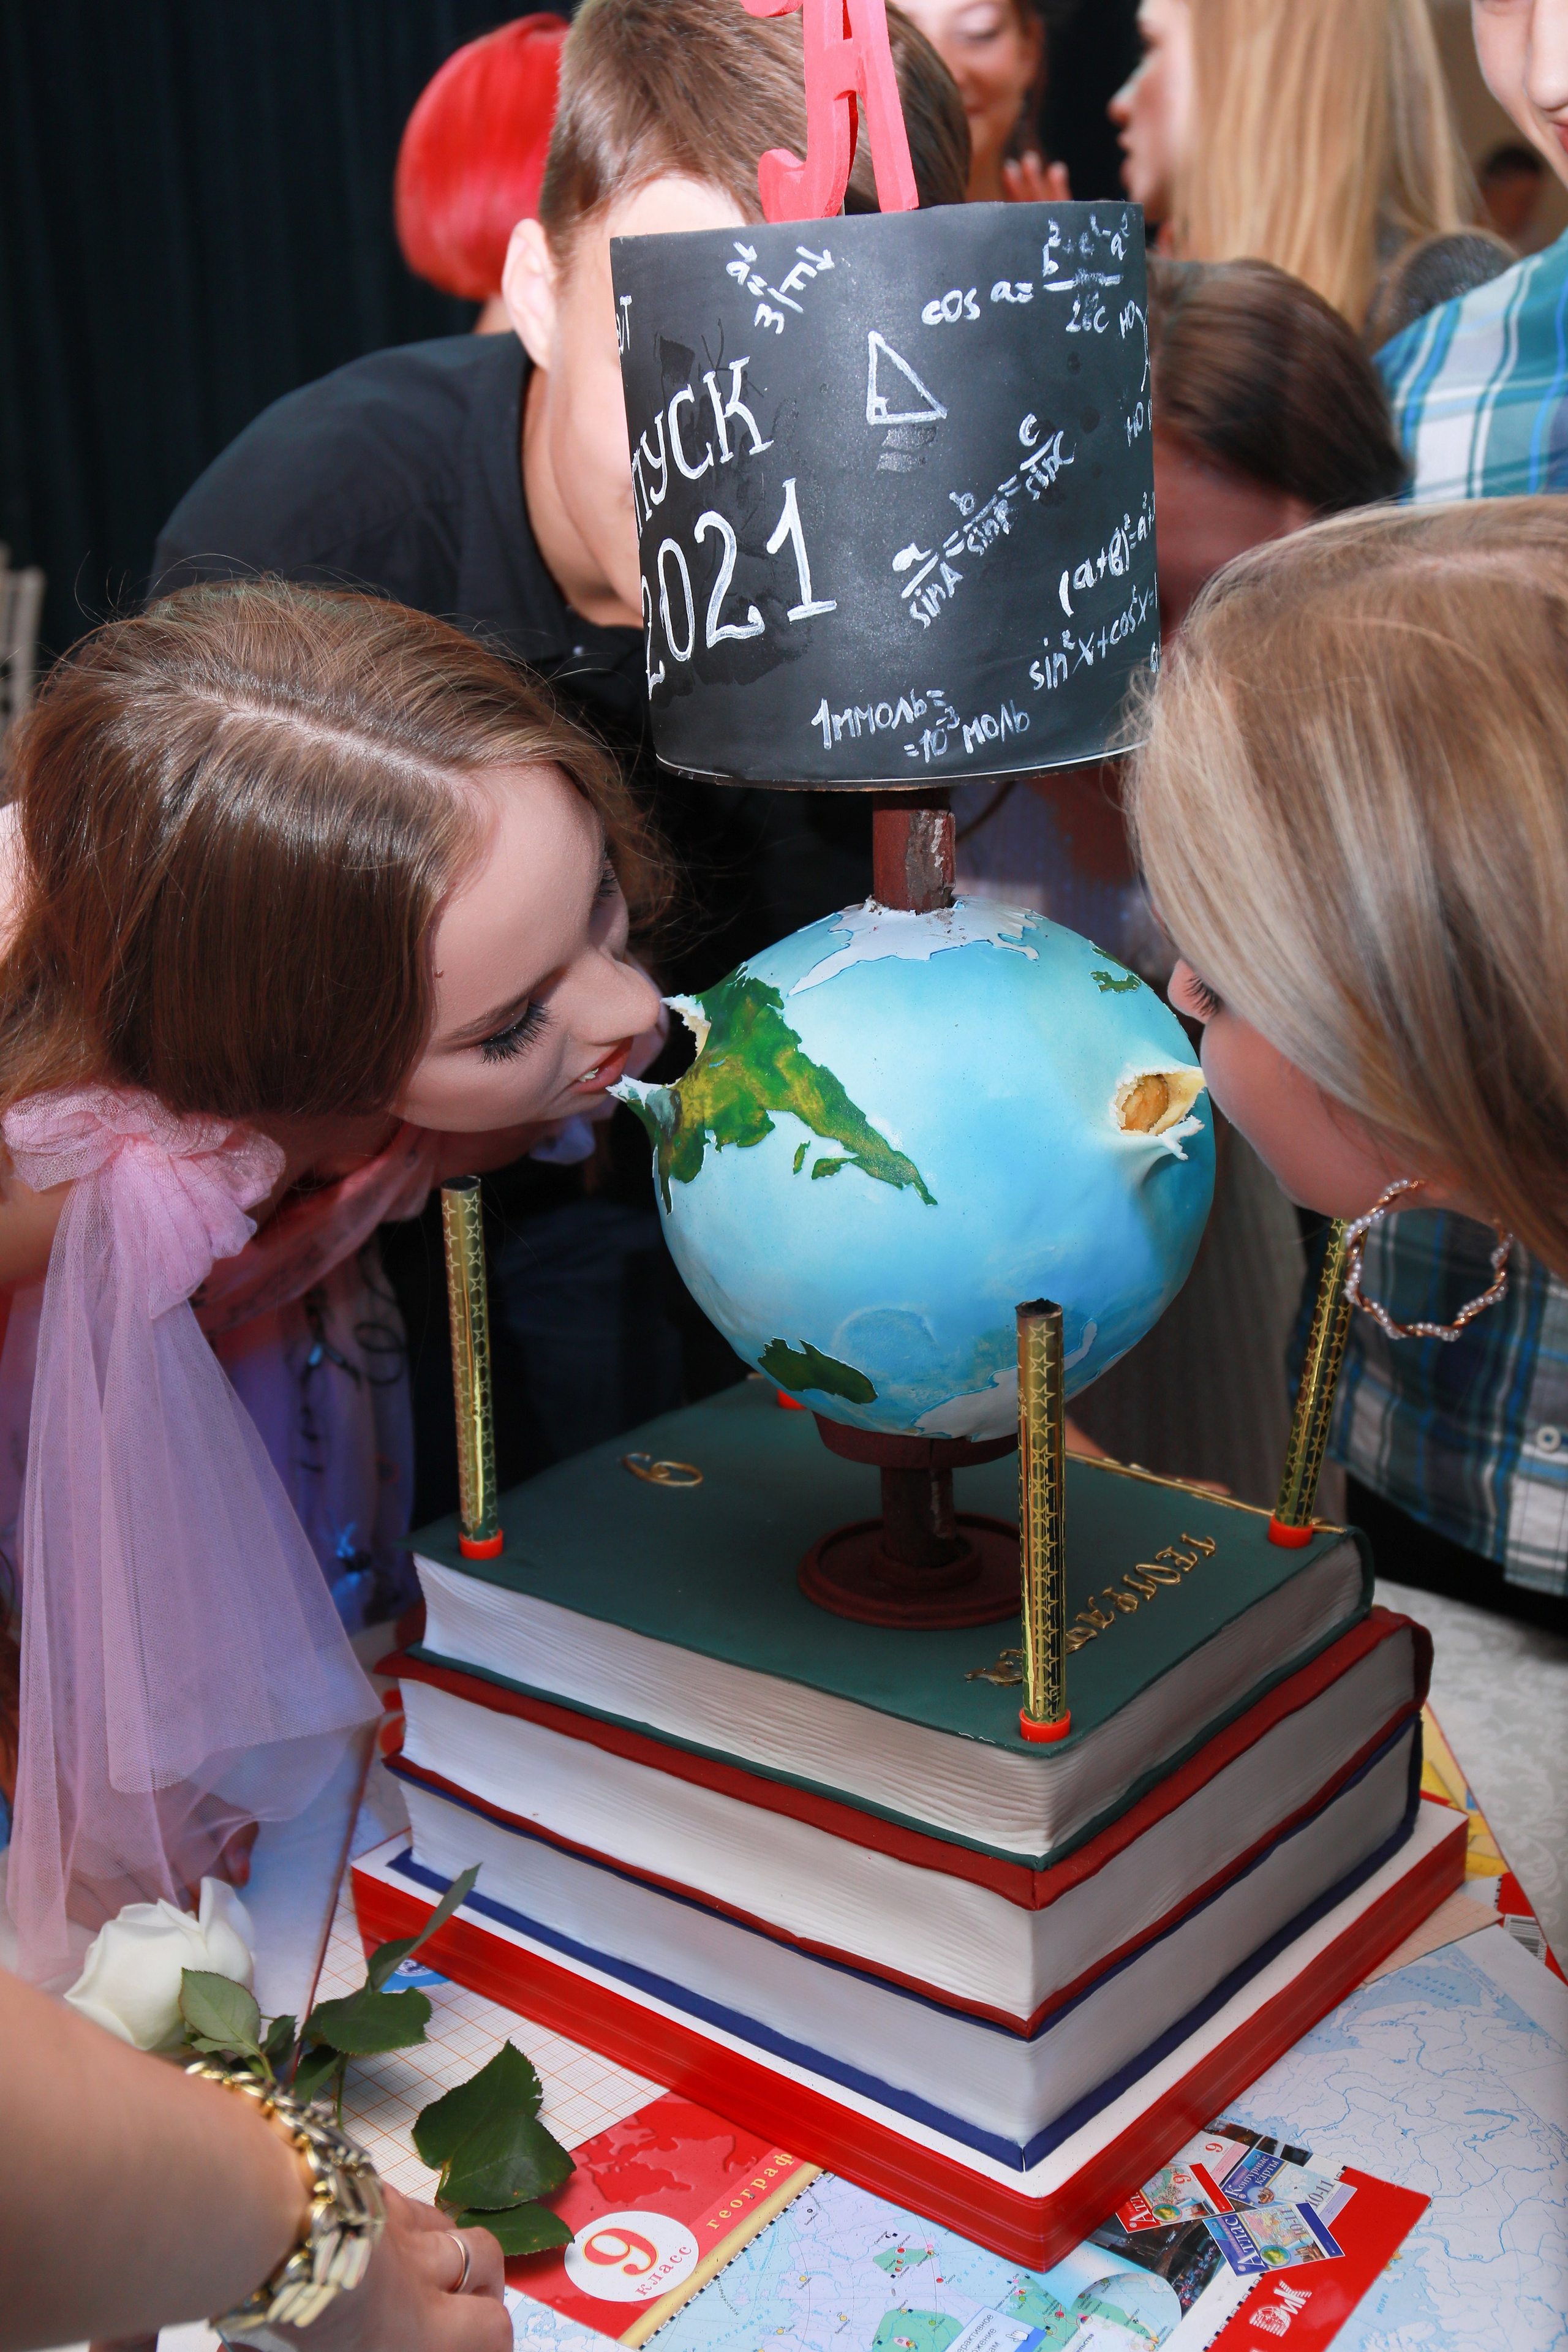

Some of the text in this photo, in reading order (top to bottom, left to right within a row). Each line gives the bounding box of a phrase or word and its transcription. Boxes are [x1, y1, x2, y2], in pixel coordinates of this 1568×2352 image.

[921, 287, 981, 325] cos
[1205, 2142, 1224, 2154] 9
[1173, 2173, 1192, 2185] 9
[1225, 2154, 1271, 2197] Контурные
[582, 2227, 659, 2277] 9
[1224, 2218, 1267, 2269] Атлас
[635, 2245, 692, 2297] класс
